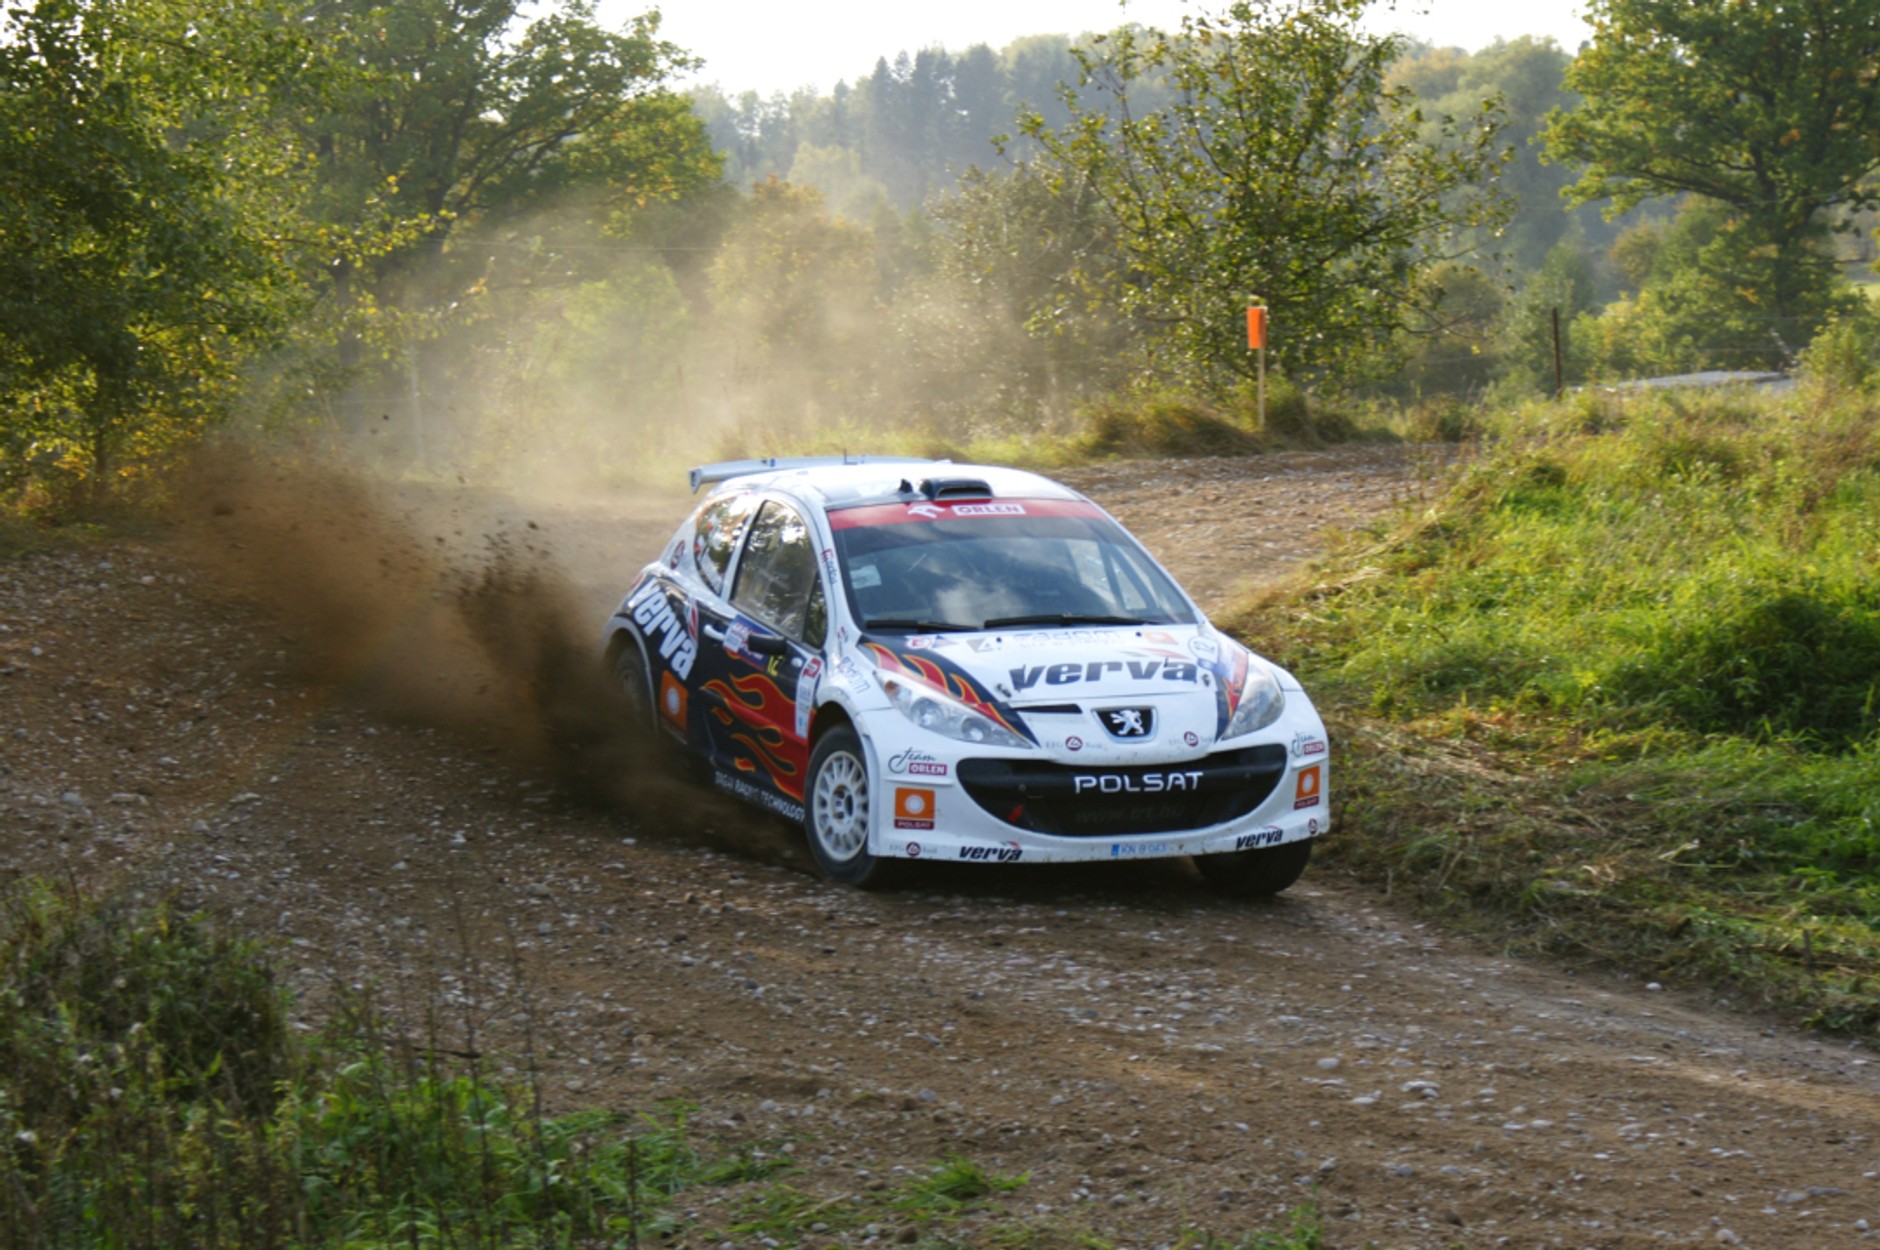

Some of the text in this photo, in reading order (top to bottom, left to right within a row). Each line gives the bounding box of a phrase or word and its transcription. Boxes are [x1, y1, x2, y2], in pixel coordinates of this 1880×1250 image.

[957, 503, 1023, 515] ORLEN
[627, 575, 697, 682] verva
[1009, 660, 1198, 691] verva
[909, 763, 946, 775] ORLEN
[1074, 771, 1204, 794] POLSAT
[897, 819, 933, 829] POLSAT
[1236, 829, 1283, 850] verva
[959, 846, 1022, 861] verva
